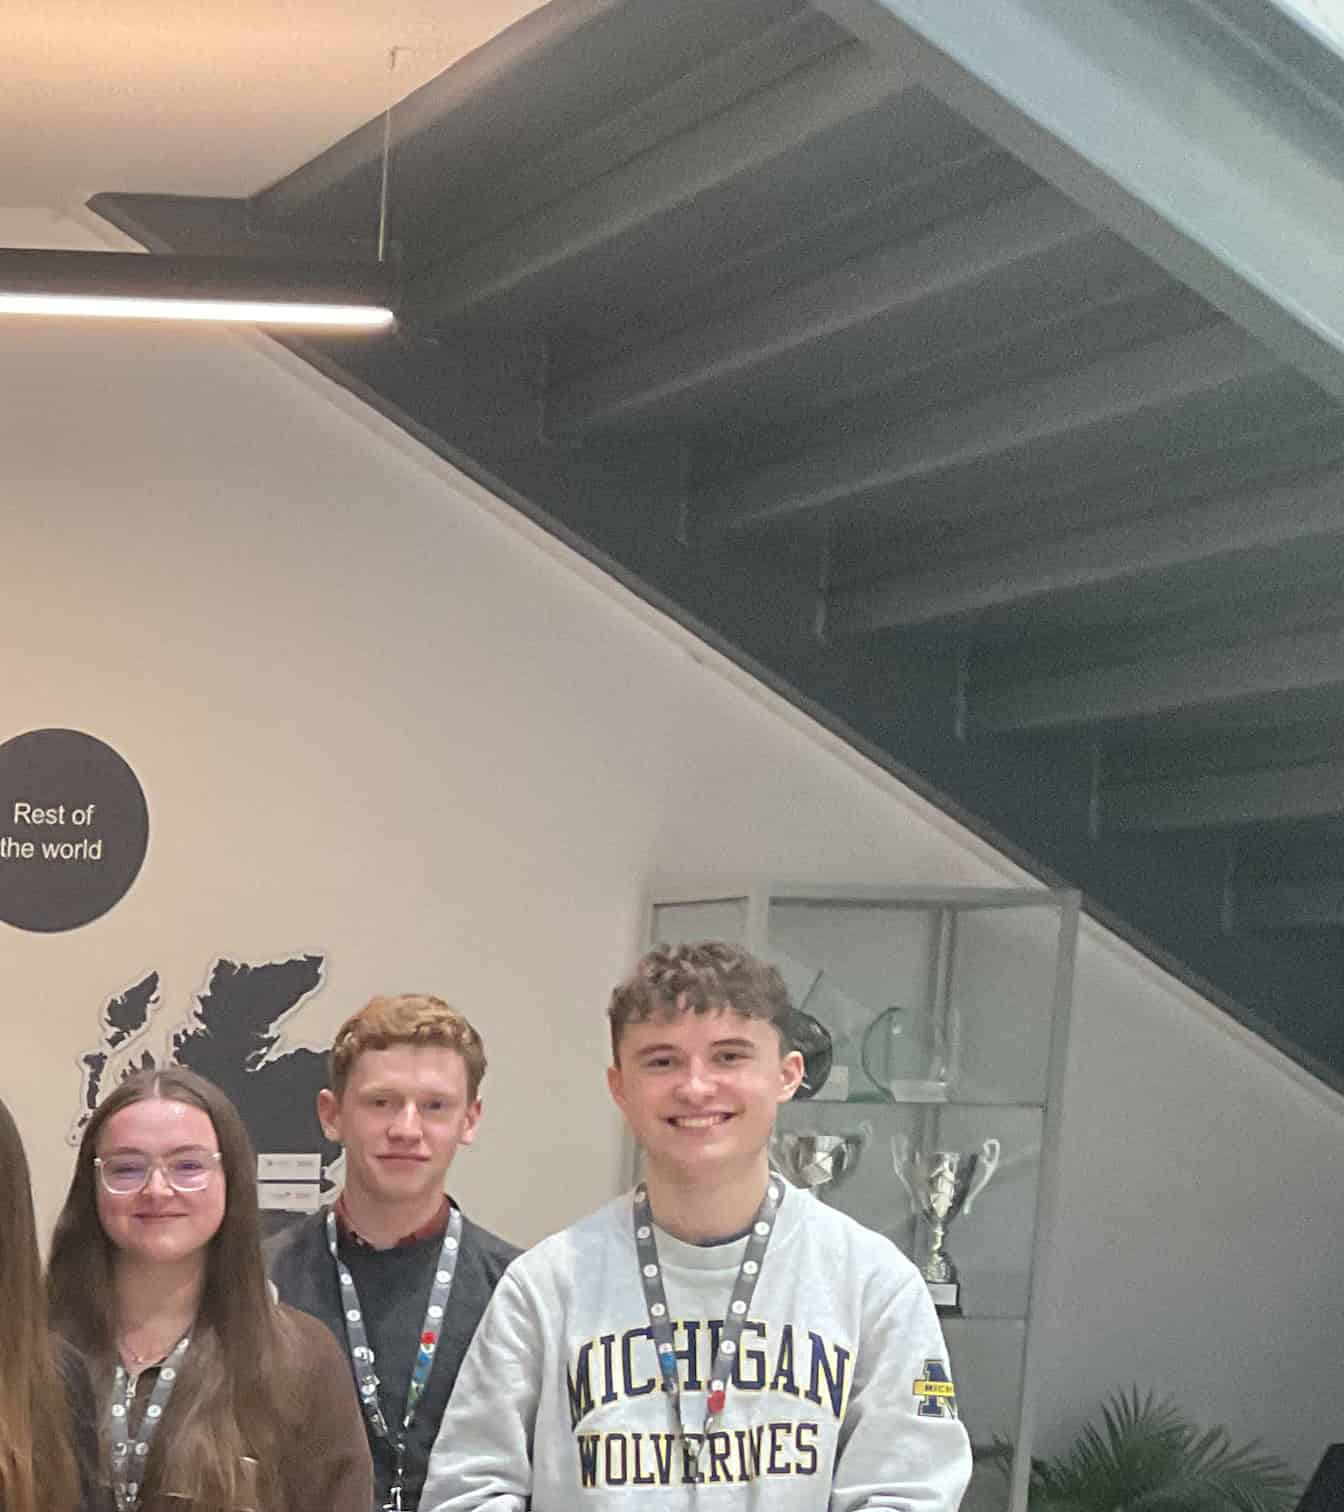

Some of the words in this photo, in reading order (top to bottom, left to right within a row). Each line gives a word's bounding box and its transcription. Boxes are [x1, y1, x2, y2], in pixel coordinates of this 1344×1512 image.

[14, 802, 64, 825] Rest
[71, 804, 97, 826] of
[0, 836, 34, 859] the
[41, 838, 102, 860] world
[576, 1423, 819, 1488] WOLVERINES
